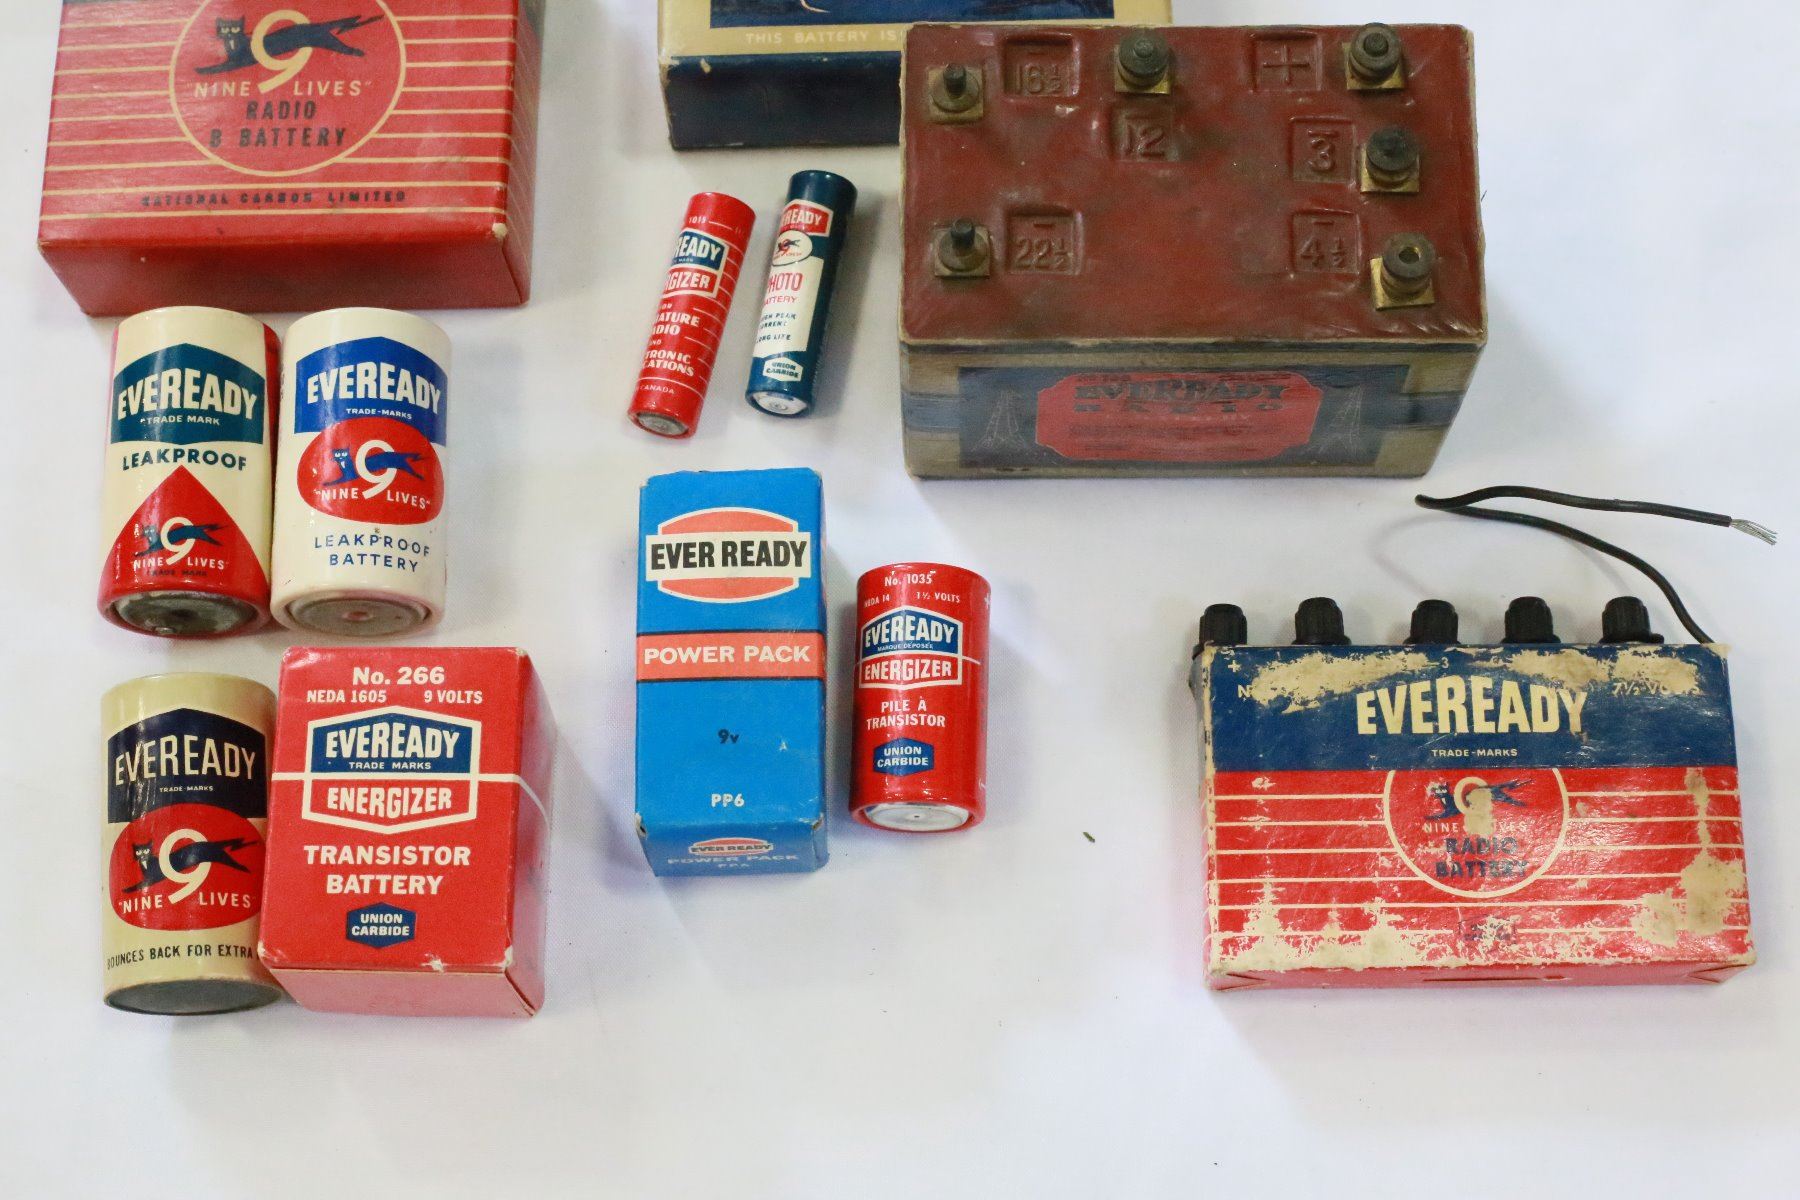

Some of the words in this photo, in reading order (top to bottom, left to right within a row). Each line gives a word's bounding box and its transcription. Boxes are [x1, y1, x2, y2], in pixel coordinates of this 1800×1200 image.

[745, 32, 783, 45] THIS
[245, 100, 317, 120] RADIO
[209, 128, 223, 148] B
[239, 127, 347, 148] BATTERY
[239, 191, 313, 205] CARBON
[327, 190, 406, 203] LIMITED
[783, 208, 822, 226] READY
[765, 367, 800, 379] CARBIDE
[771, 361, 797, 371] UNION
[117, 367, 258, 421] EVEREADY
[307, 361, 442, 415] EVEREADY
[147, 415, 183, 425] TRADE
[187, 415, 221, 425] MARK
[122, 448, 247, 471] LEAKPROOF
[314, 533, 431, 557] LEAKPROOF
[329, 553, 419, 573] BATTERY
[650, 541, 716, 571] EVER
[720, 539, 808, 568] READY
[906, 573, 933, 585] 1035
[882, 593, 890, 603] 14
[934, 592, 961, 604] VOLTS
[864, 614, 955, 649] EVEREADY
[643, 645, 735, 665] POWER
[743, 645, 811, 663] PACK
[352, 666, 391, 686] No.
[396, 666, 446, 685] 266
[864, 658, 952, 681] ENERGIZER
[306, 689, 346, 704] NEDA
[350, 689, 387, 704] 1605
[424, 690, 433, 703] 9
[437, 690, 484, 705] VOLTS
[881, 699, 911, 713] PILE
[1355, 674, 1588, 735] EVEREADY
[866, 713, 946, 731] TRANSISTOR
[325, 721, 460, 759] EVEREADY
[115, 734, 256, 786] EVEREADY
[883, 745, 922, 757] UNION
[349, 761, 386, 770] TRADE
[391, 761, 432, 770] MARKS
[876, 756, 929, 768] CARBIDE
[327, 786, 453, 819] ENERGIZER
[710, 793, 745, 808] PP6
[691, 845, 727, 854] EVER
[728, 843, 771, 852] READY
[1445, 836, 1518, 855] RADIO
[303, 845, 471, 866] TRANSISTOR
[667, 856, 739, 865] POWER
[746, 854, 800, 862] PACK
[1435, 859, 1529, 878] BATTERY
[325, 874, 444, 895] BATTERY
[359, 913, 403, 924] UNION
[351, 925, 410, 937] CARBIDE
[107, 949, 145, 971] BOUNCES
[149, 945, 181, 960] BACK
[187, 944, 212, 957] FOR
[218, 944, 253, 958] EXTRA
